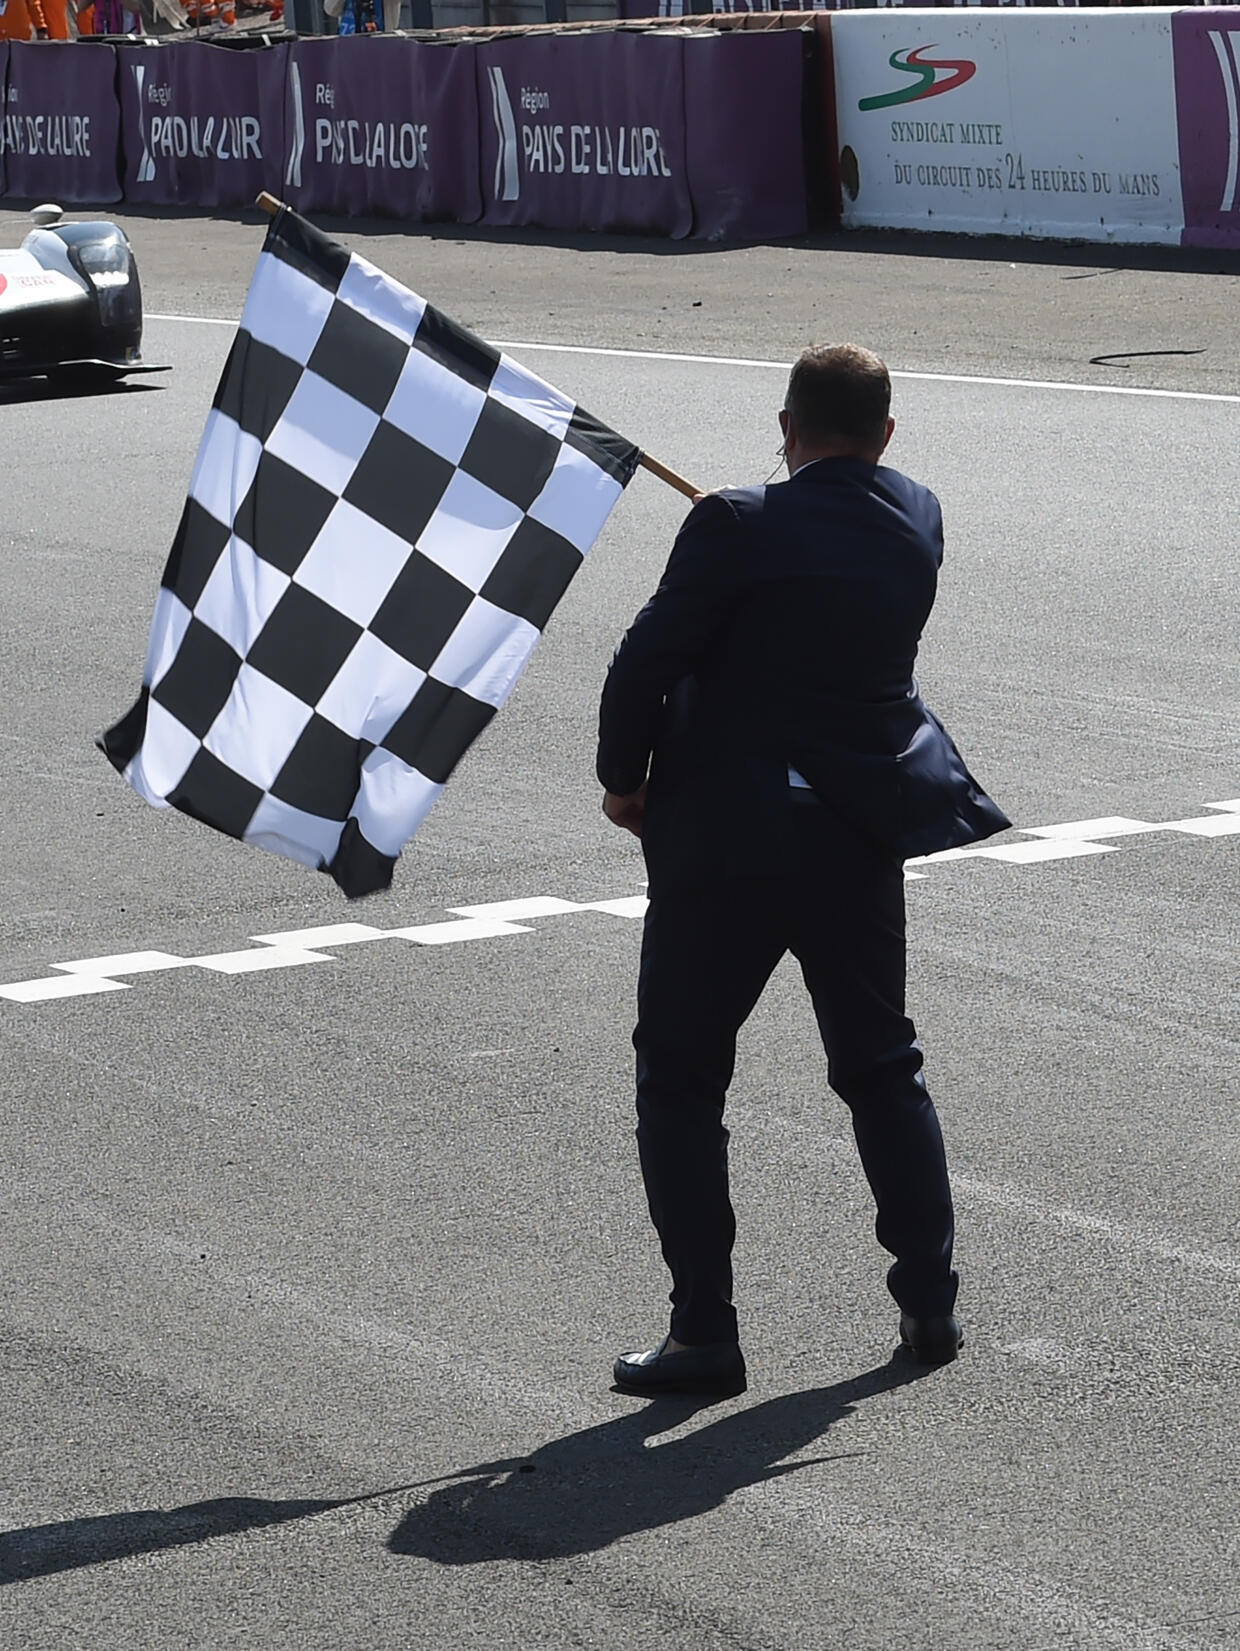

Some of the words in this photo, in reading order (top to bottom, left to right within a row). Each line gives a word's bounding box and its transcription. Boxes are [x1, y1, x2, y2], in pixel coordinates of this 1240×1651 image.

[521, 87, 549, 114] Région
[522, 125, 566, 174] PAYS
[570, 125, 591, 175] DE
[891, 121, 955, 144] SYNDICAT
[960, 124, 1003, 145] MIXTE
[894, 164, 912, 185] DU
[917, 165, 971, 188] CIRCUIT
[976, 167, 1002, 189] DES
[1005, 152, 1026, 190] 24
[1031, 169, 1087, 193] HEURES
[1093, 172, 1112, 194] DU
[1119, 174, 1160, 197] MANS
